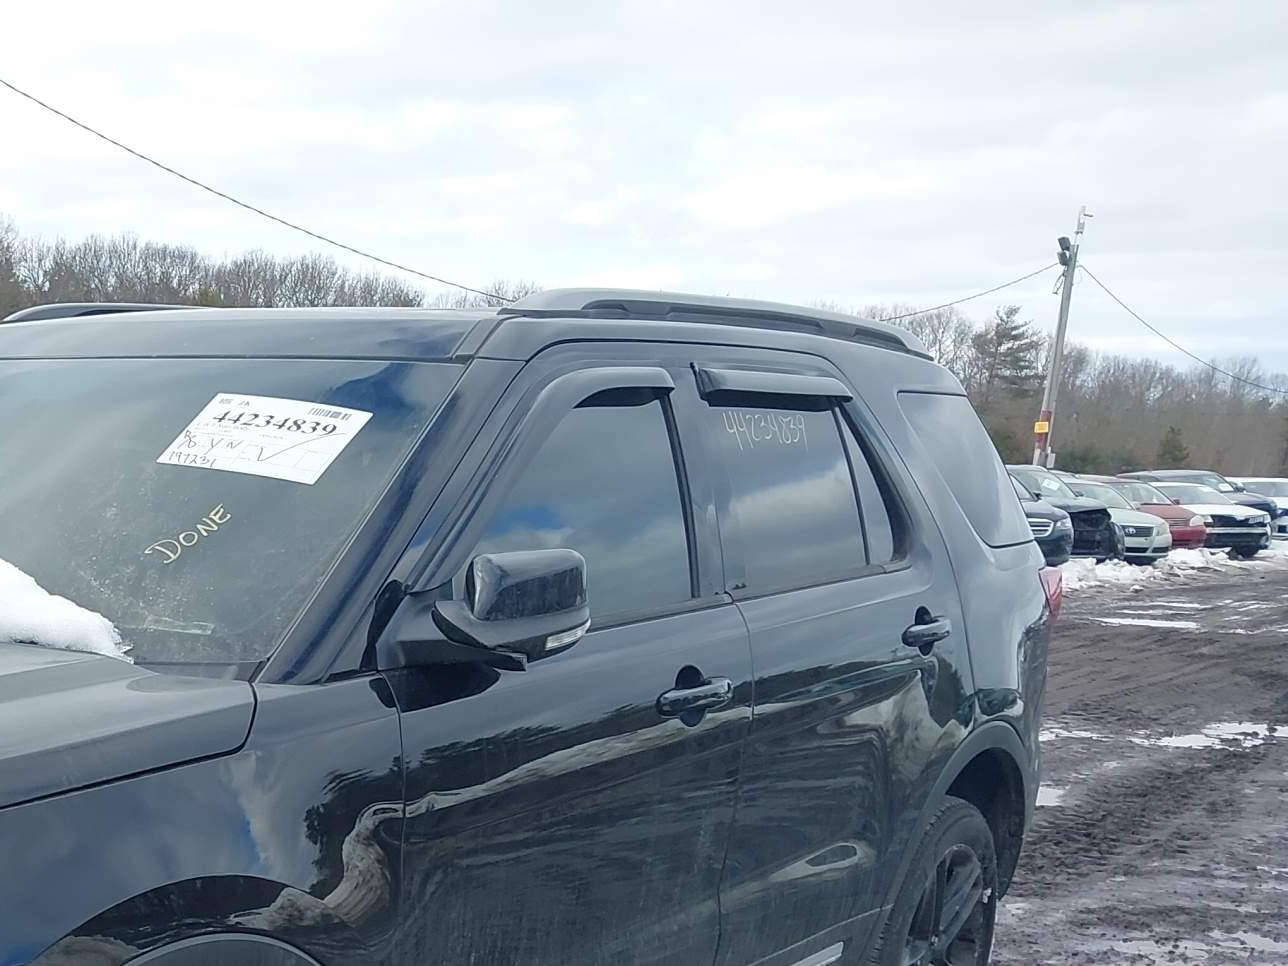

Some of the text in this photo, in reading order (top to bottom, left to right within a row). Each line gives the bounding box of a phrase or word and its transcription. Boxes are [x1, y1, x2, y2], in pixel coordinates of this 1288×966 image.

[212, 410, 337, 436] 44234839
[722, 411, 808, 452] 44234839
[143, 503, 232, 564] DONE
